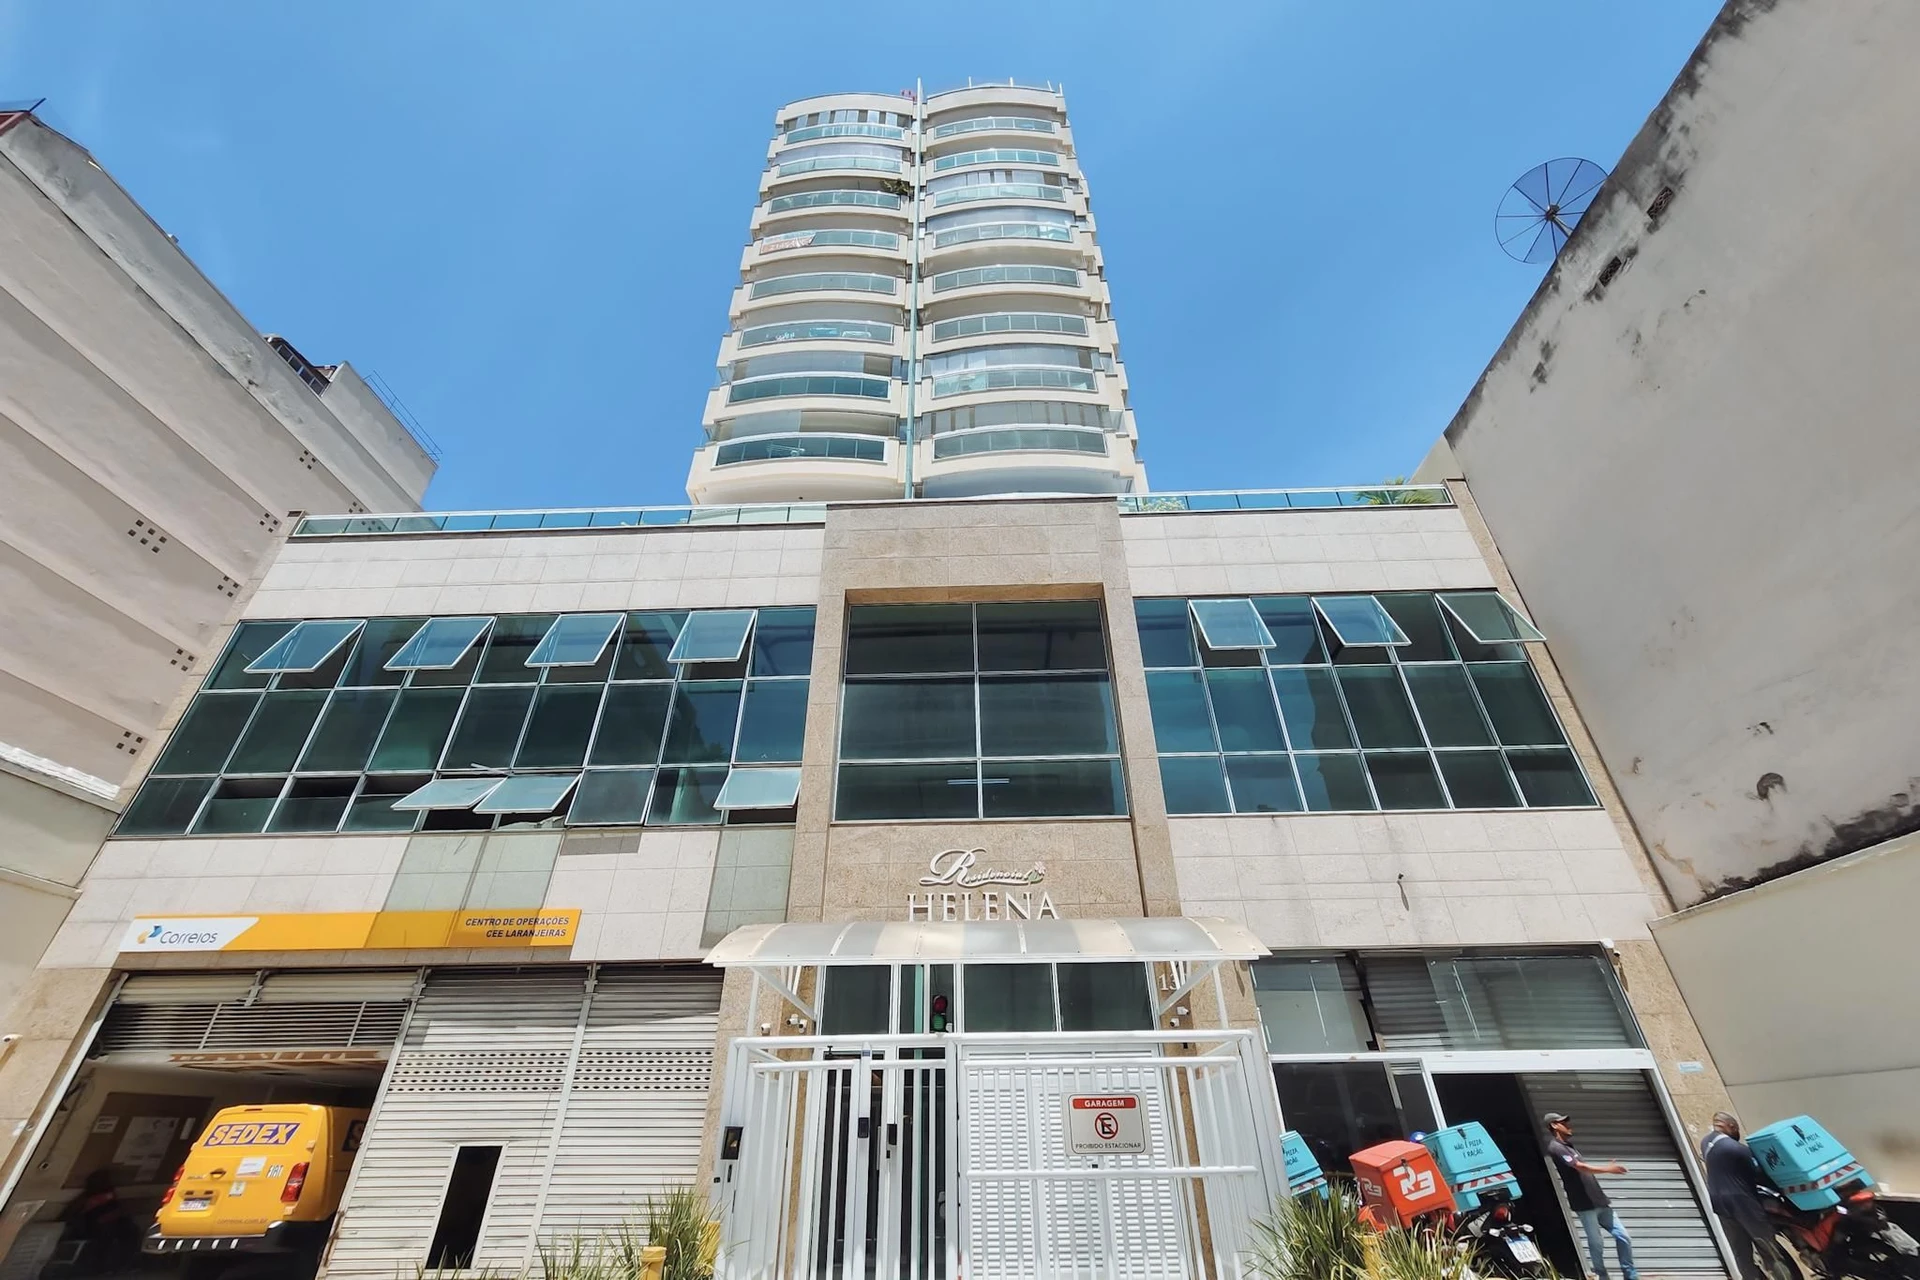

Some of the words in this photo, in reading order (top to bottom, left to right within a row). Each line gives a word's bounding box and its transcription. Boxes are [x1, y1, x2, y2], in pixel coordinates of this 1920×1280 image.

[907, 891, 1060, 922] HELENA
[465, 918, 501, 926] CENTRO
[516, 916, 569, 926] OPERAÇÕES
[160, 931, 218, 944] Correios
[505, 929, 566, 937] LARANJEIRAS
[1084, 1099, 1125, 1108] GARAGEM
[208, 1123, 298, 1146] SEDEX
